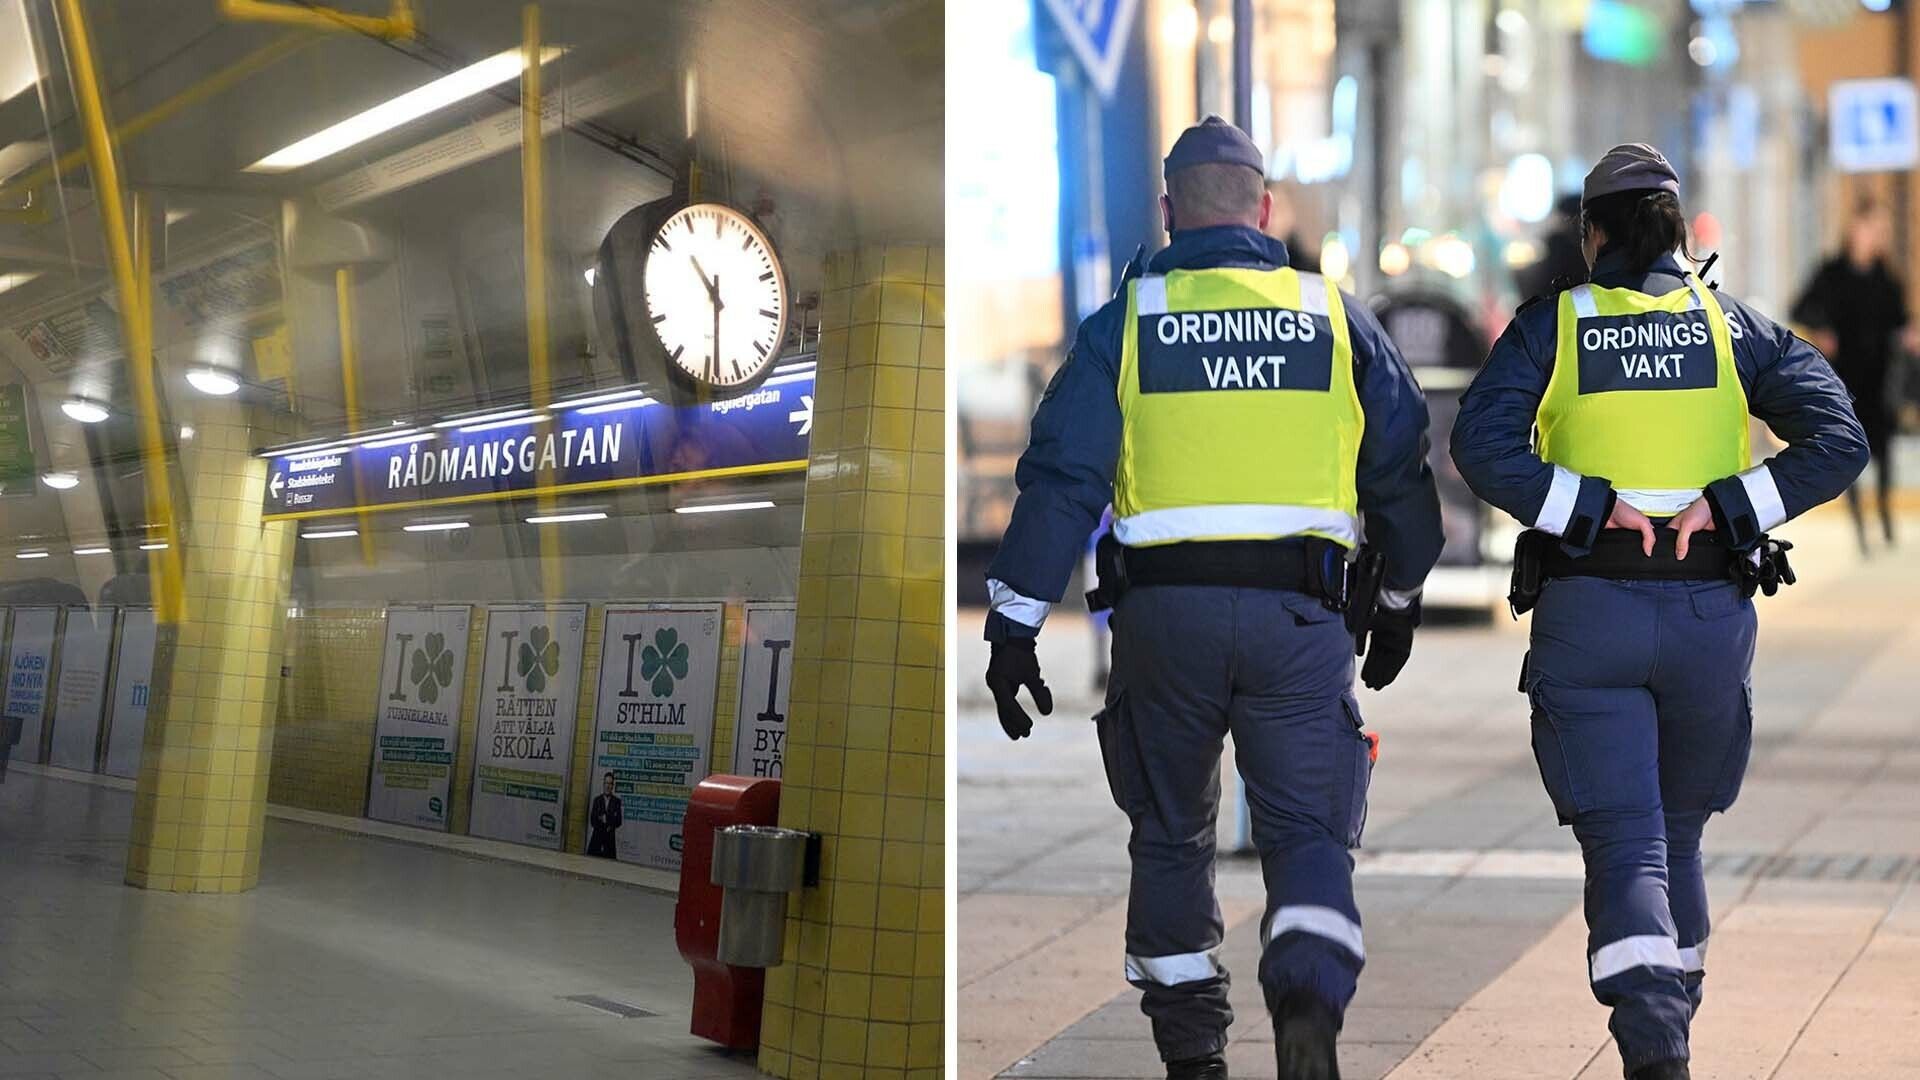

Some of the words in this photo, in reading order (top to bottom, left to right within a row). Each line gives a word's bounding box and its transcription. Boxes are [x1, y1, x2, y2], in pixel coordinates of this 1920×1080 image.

[1157, 310, 1316, 345] ORDNINGS
[1582, 321, 1708, 351] ORDNINGS
[1202, 355, 1287, 389] VAKT
[1620, 353, 1685, 379] VAKT
[387, 423, 623, 489] RÅDMANSGATAN
[618, 633, 642, 698] I
[756, 639, 791, 723] I
[496, 693, 557, 717] RÄTTEN
[617, 702, 687, 726] STHLM
[493, 719, 515, 734] ATT
[518, 717, 556, 736] VÄLJA
[491, 735, 555, 761] SKOLA
